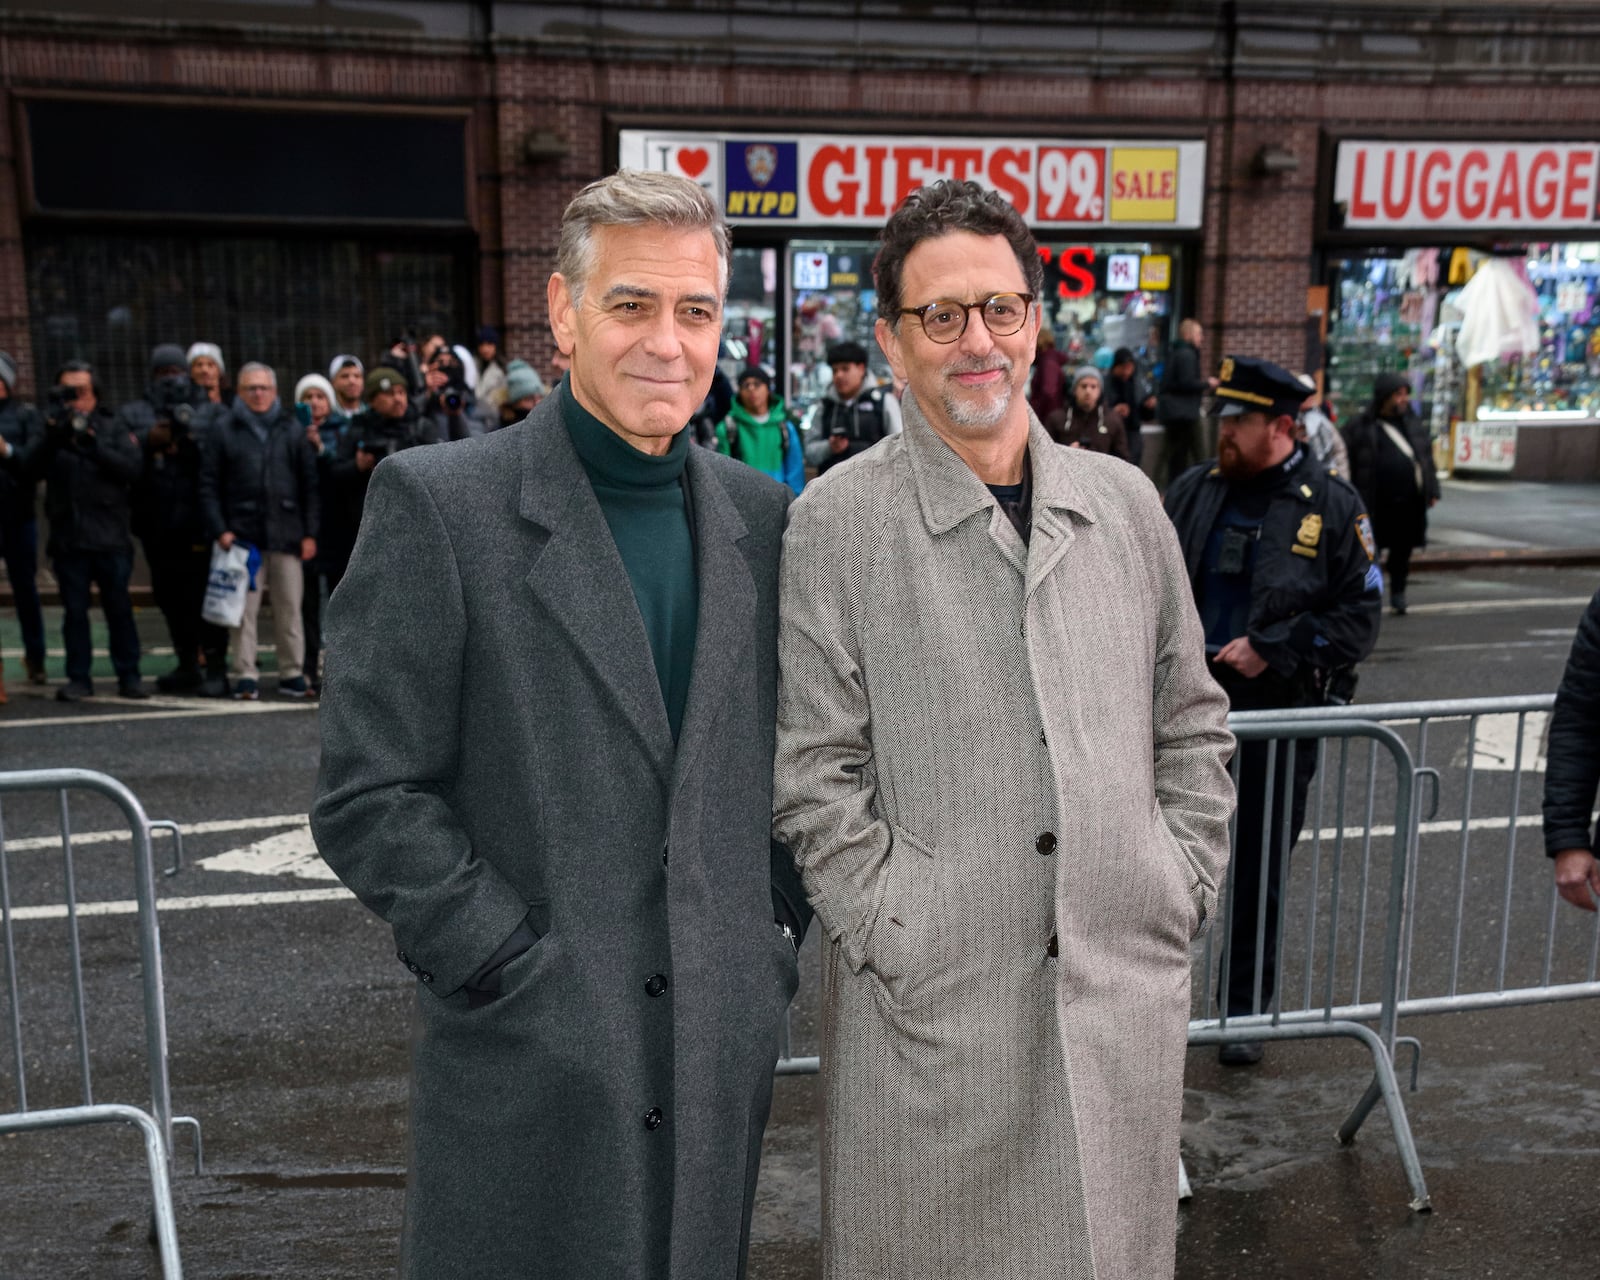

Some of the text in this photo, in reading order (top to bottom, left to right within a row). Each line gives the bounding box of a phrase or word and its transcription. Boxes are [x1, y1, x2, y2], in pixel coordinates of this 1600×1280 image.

[727, 191, 797, 215] NYPD
[807, 144, 1031, 218] GIFTS
[1113, 170, 1176, 200] SALE
[1352, 149, 1594, 221] LUGGAGE
